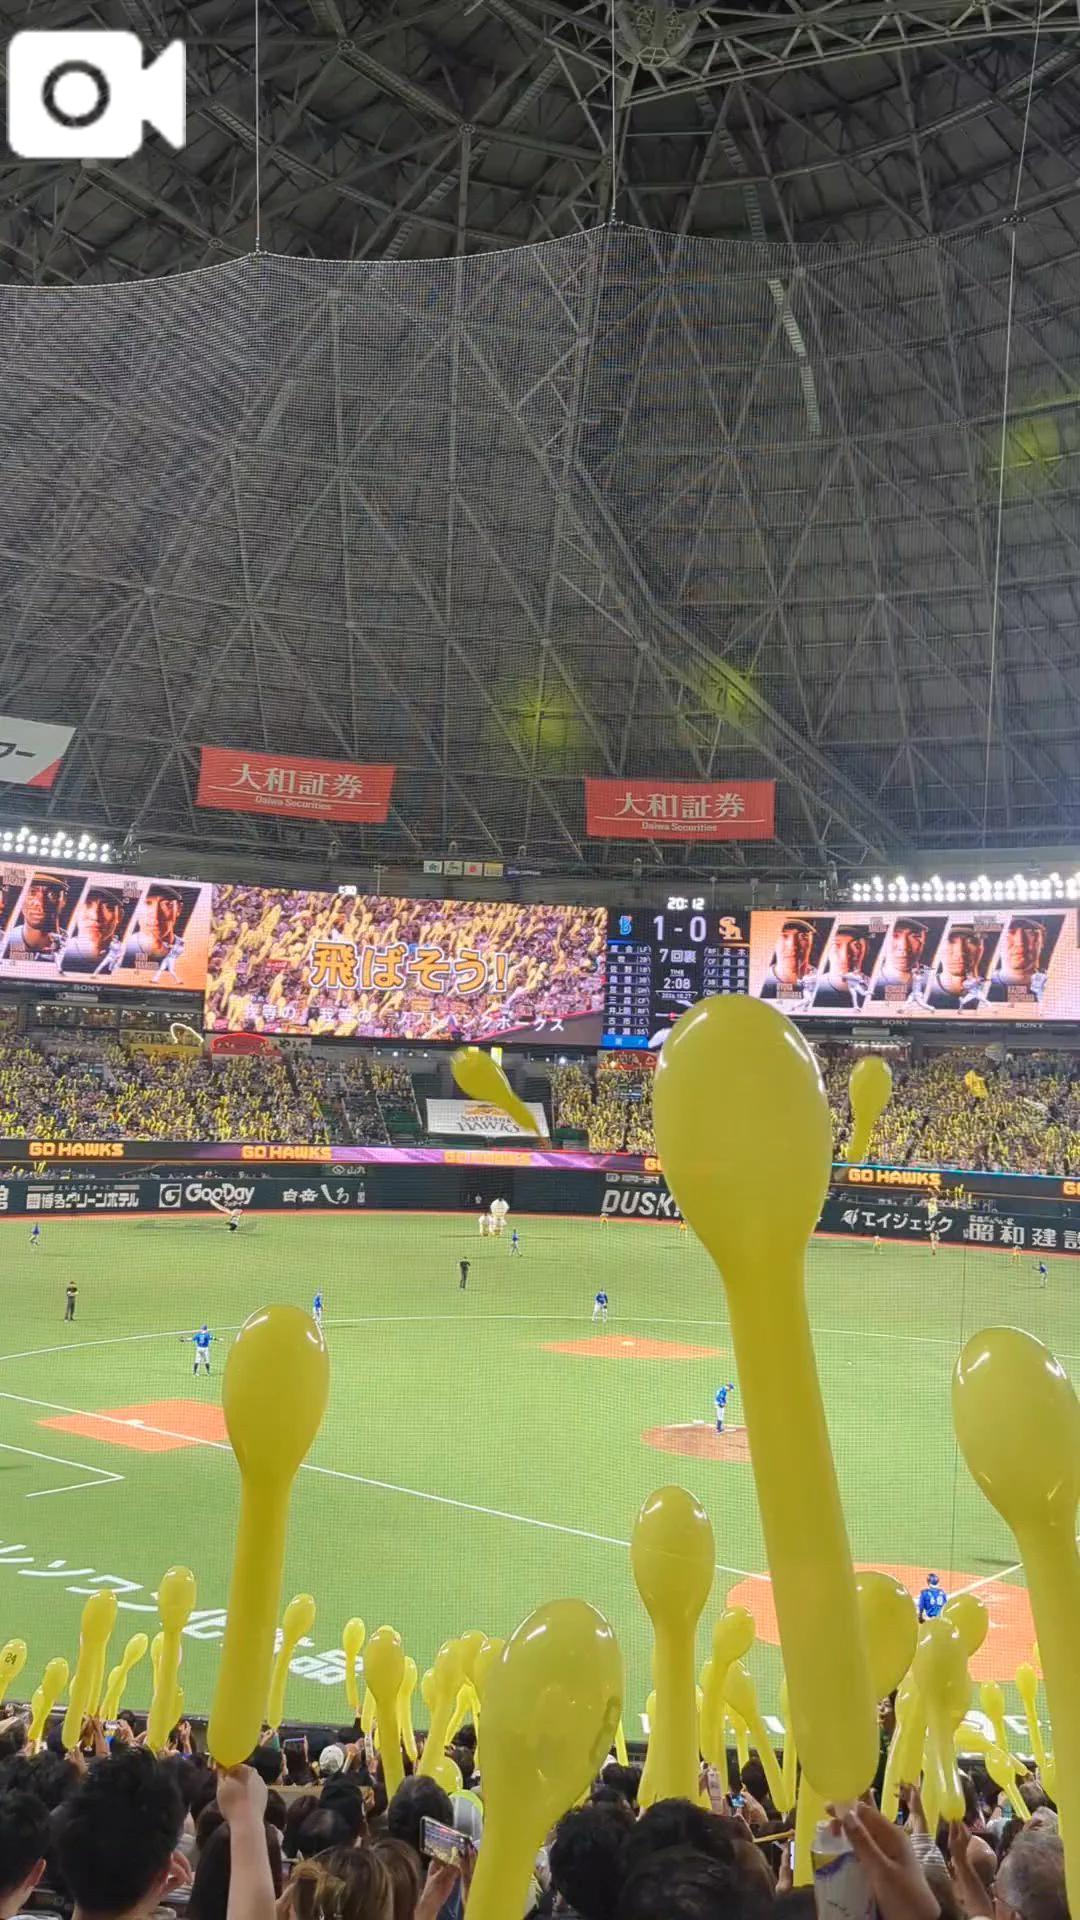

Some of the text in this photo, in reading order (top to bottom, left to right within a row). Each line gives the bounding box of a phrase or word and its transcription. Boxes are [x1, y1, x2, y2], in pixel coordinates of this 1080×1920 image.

[230, 763, 363, 799] 大和証券
[255, 795, 332, 810] Daiwa Securities
[615, 792, 745, 819] 大和証券
[642, 821, 717, 832] Daiwa Securities
[667, 897, 704, 910] 20:12
[659, 949, 697, 963] 7回裏
[663, 977, 691, 989] 2:08
[29, 1142, 125, 1157] GO HAWKS
[241, 1145, 332, 1160] GO HAWKS
[848, 1168, 941, 1186] GO HAWKS
[42, 1191, 139, 1209] 博多グリーンホテル
[185, 1183, 255, 1205] GooDay
[861, 1211, 953, 1233] エイジェック
